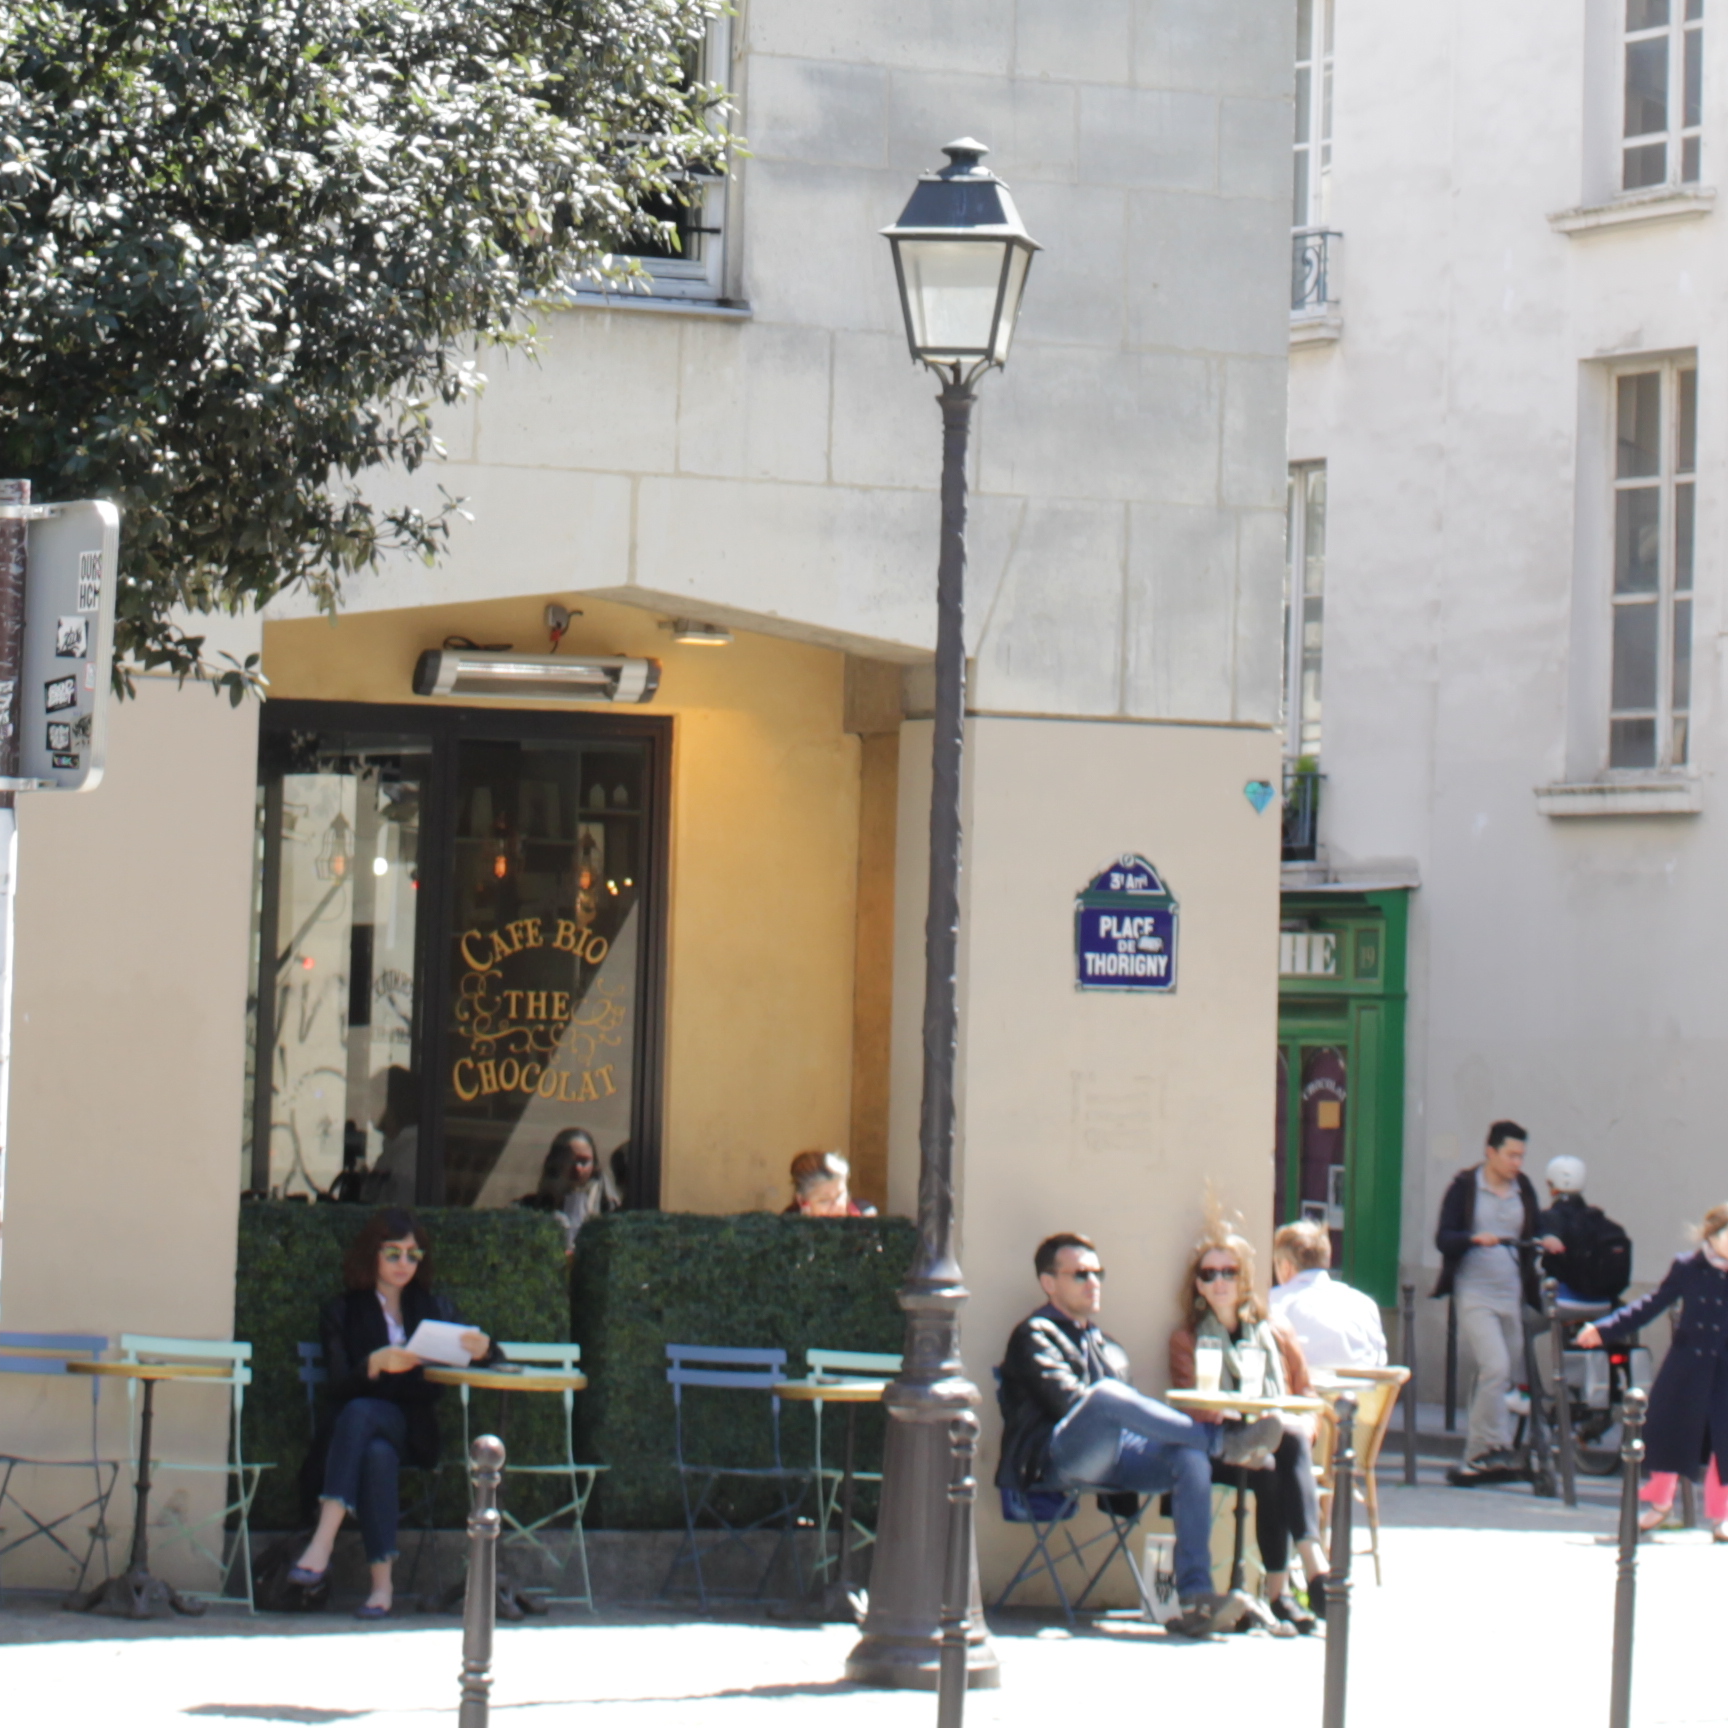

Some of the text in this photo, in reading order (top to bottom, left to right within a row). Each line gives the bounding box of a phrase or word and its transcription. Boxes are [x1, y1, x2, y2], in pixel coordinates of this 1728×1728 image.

[551, 918, 609, 965] BIO
[1099, 915, 1156, 940] PLACE
[1117, 938, 1137, 954] DE
[1084, 952, 1169, 978] THORIGNY
[502, 989, 571, 1021] THE
[452, 1057, 618, 1102] CHOCOLAT
